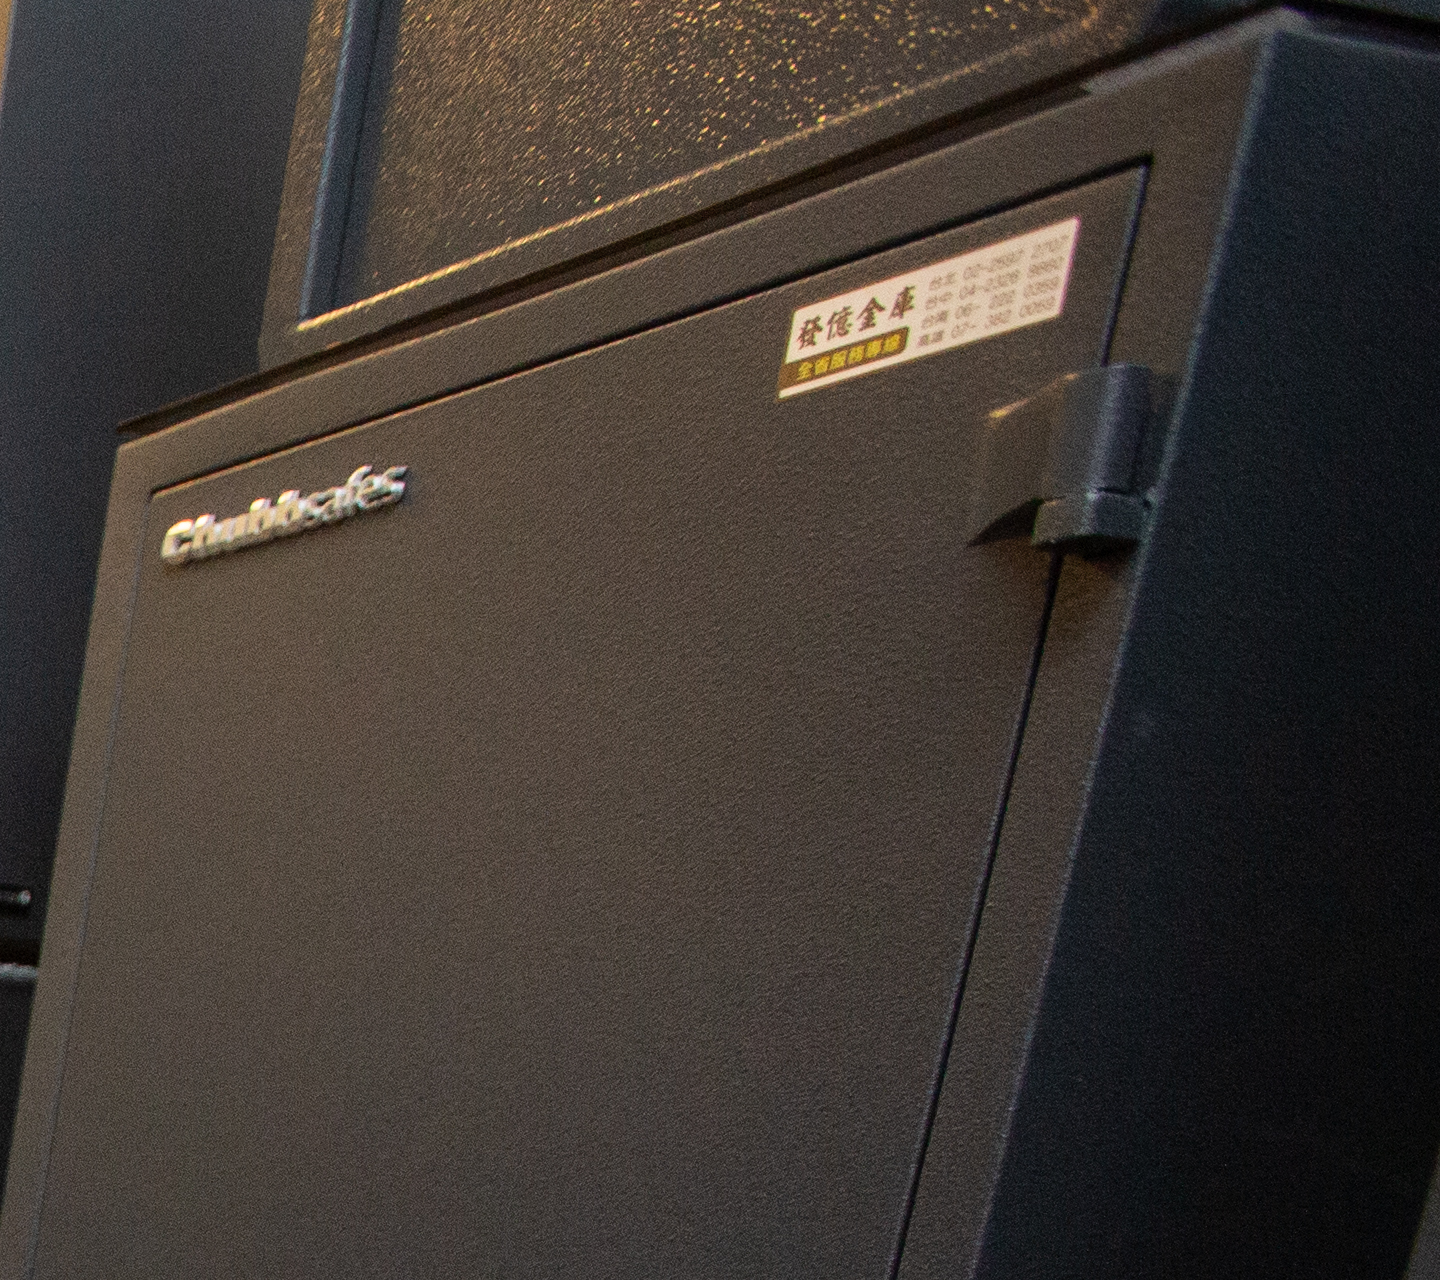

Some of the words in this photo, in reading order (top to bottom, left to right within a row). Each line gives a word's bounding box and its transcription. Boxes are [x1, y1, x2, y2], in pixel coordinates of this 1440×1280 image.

[797, 285, 916, 349] 發億金庫
[161, 465, 408, 565] Chubbsafes
